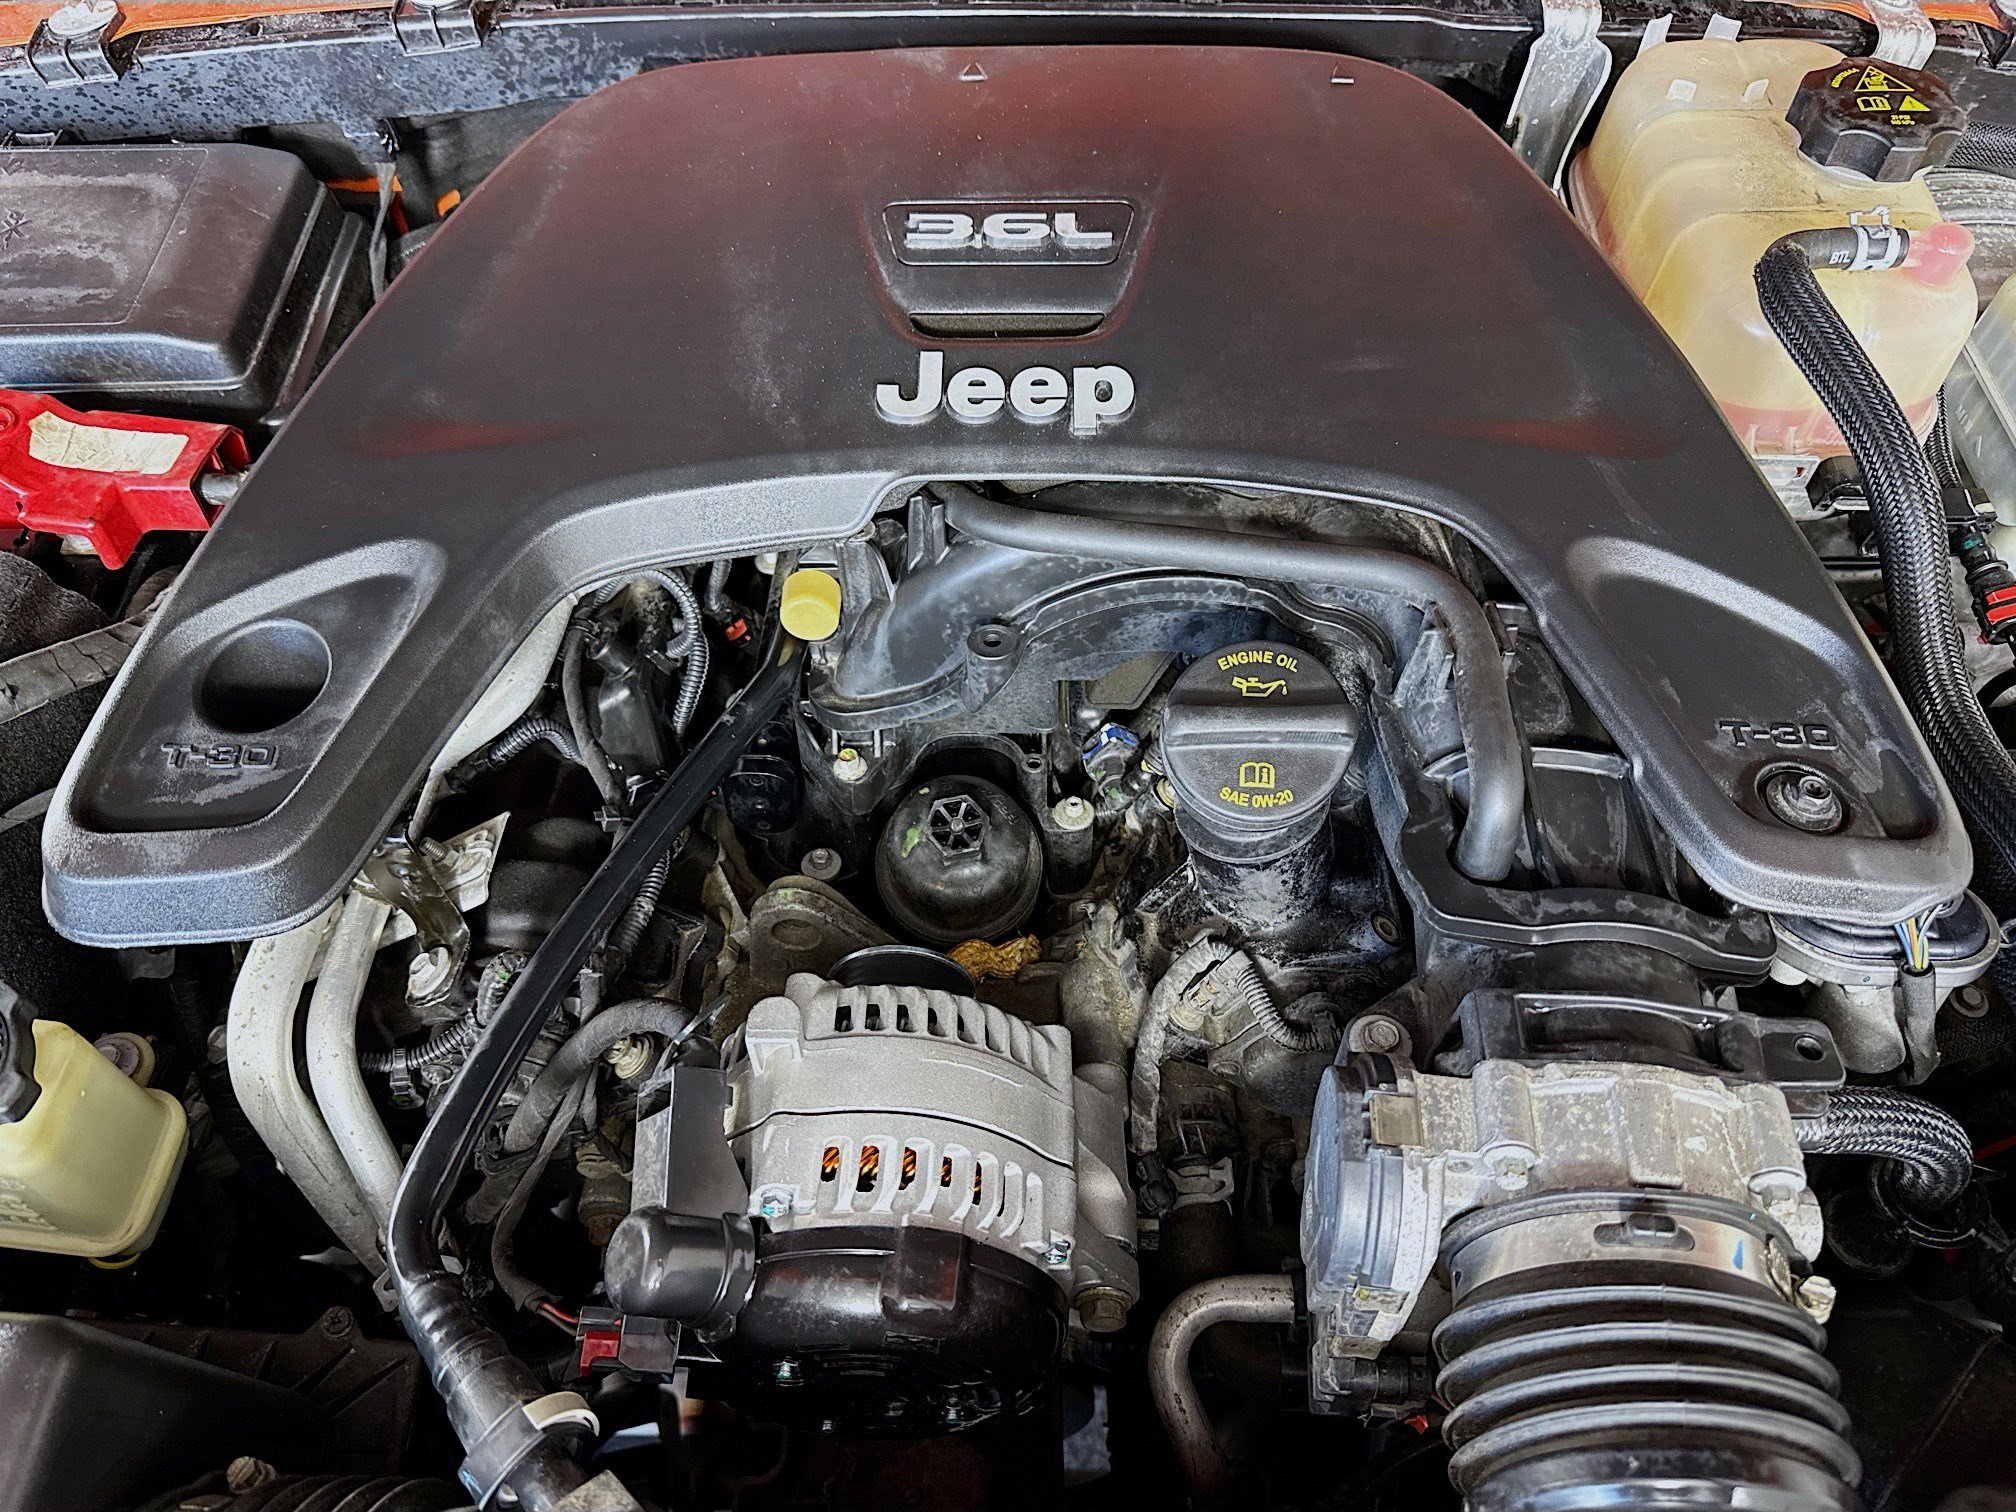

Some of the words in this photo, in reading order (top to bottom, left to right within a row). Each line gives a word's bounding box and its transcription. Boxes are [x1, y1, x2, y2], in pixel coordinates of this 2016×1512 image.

[905, 212, 1113, 249] 3.6L
[1829, 250, 1850, 264] BTL
[875, 351, 1136, 436] Jeep
[1217, 650, 1274, 671] ENGINE
[1275, 653, 1299, 673] OIL
[1718, 720, 1839, 750] T-30
[161, 742, 279, 770] T-30
[1219, 786, 1250, 808] SAE
[1251, 789, 1294, 808] 0W-20
